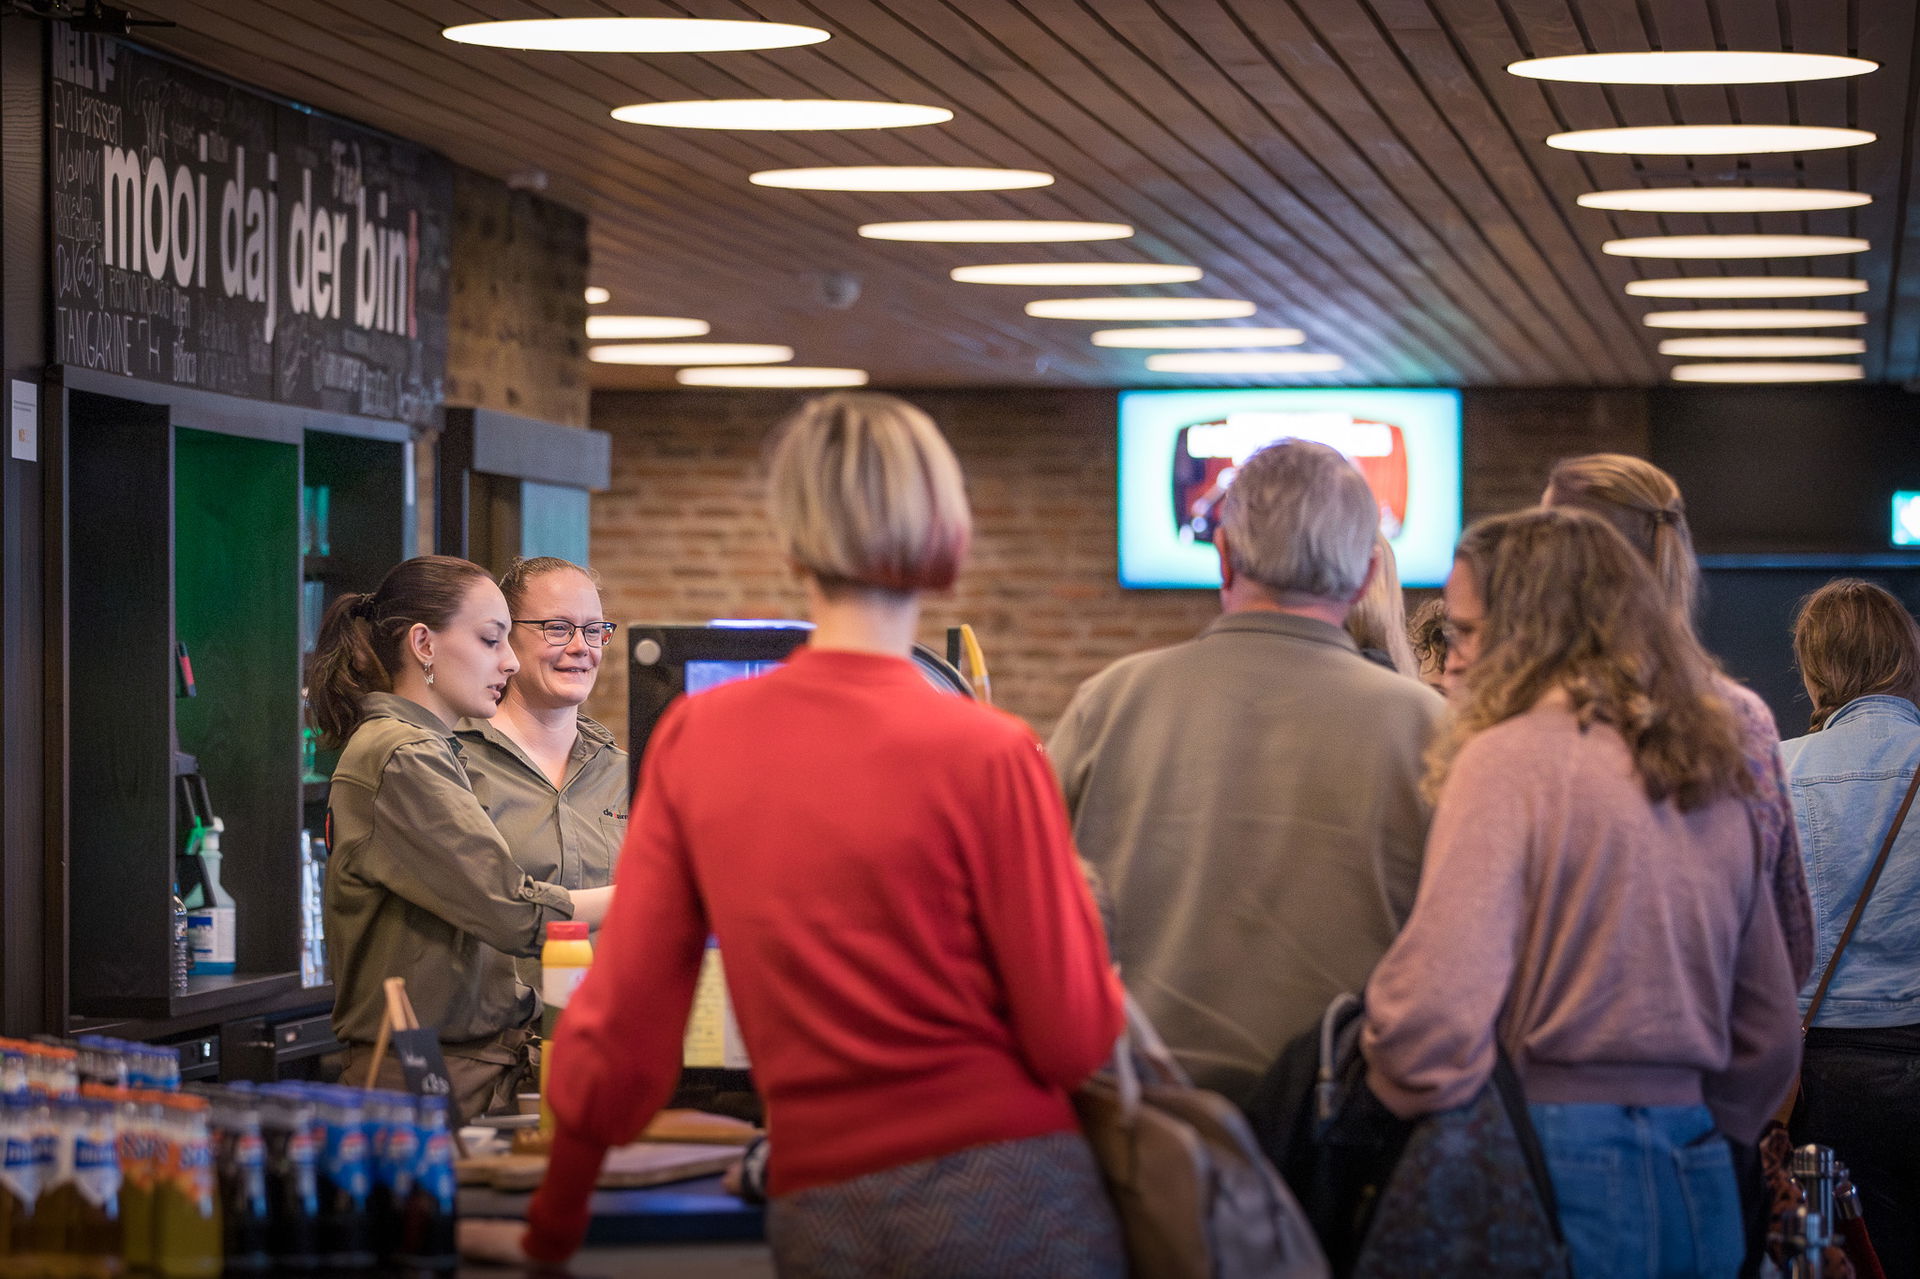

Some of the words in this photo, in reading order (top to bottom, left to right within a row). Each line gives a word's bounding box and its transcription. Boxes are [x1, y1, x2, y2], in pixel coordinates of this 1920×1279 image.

[104, 134, 207, 288] mooi
[220, 146, 278, 344] daj
[288, 168, 348, 320] der
[58, 306, 133, 377] TANGARINE
